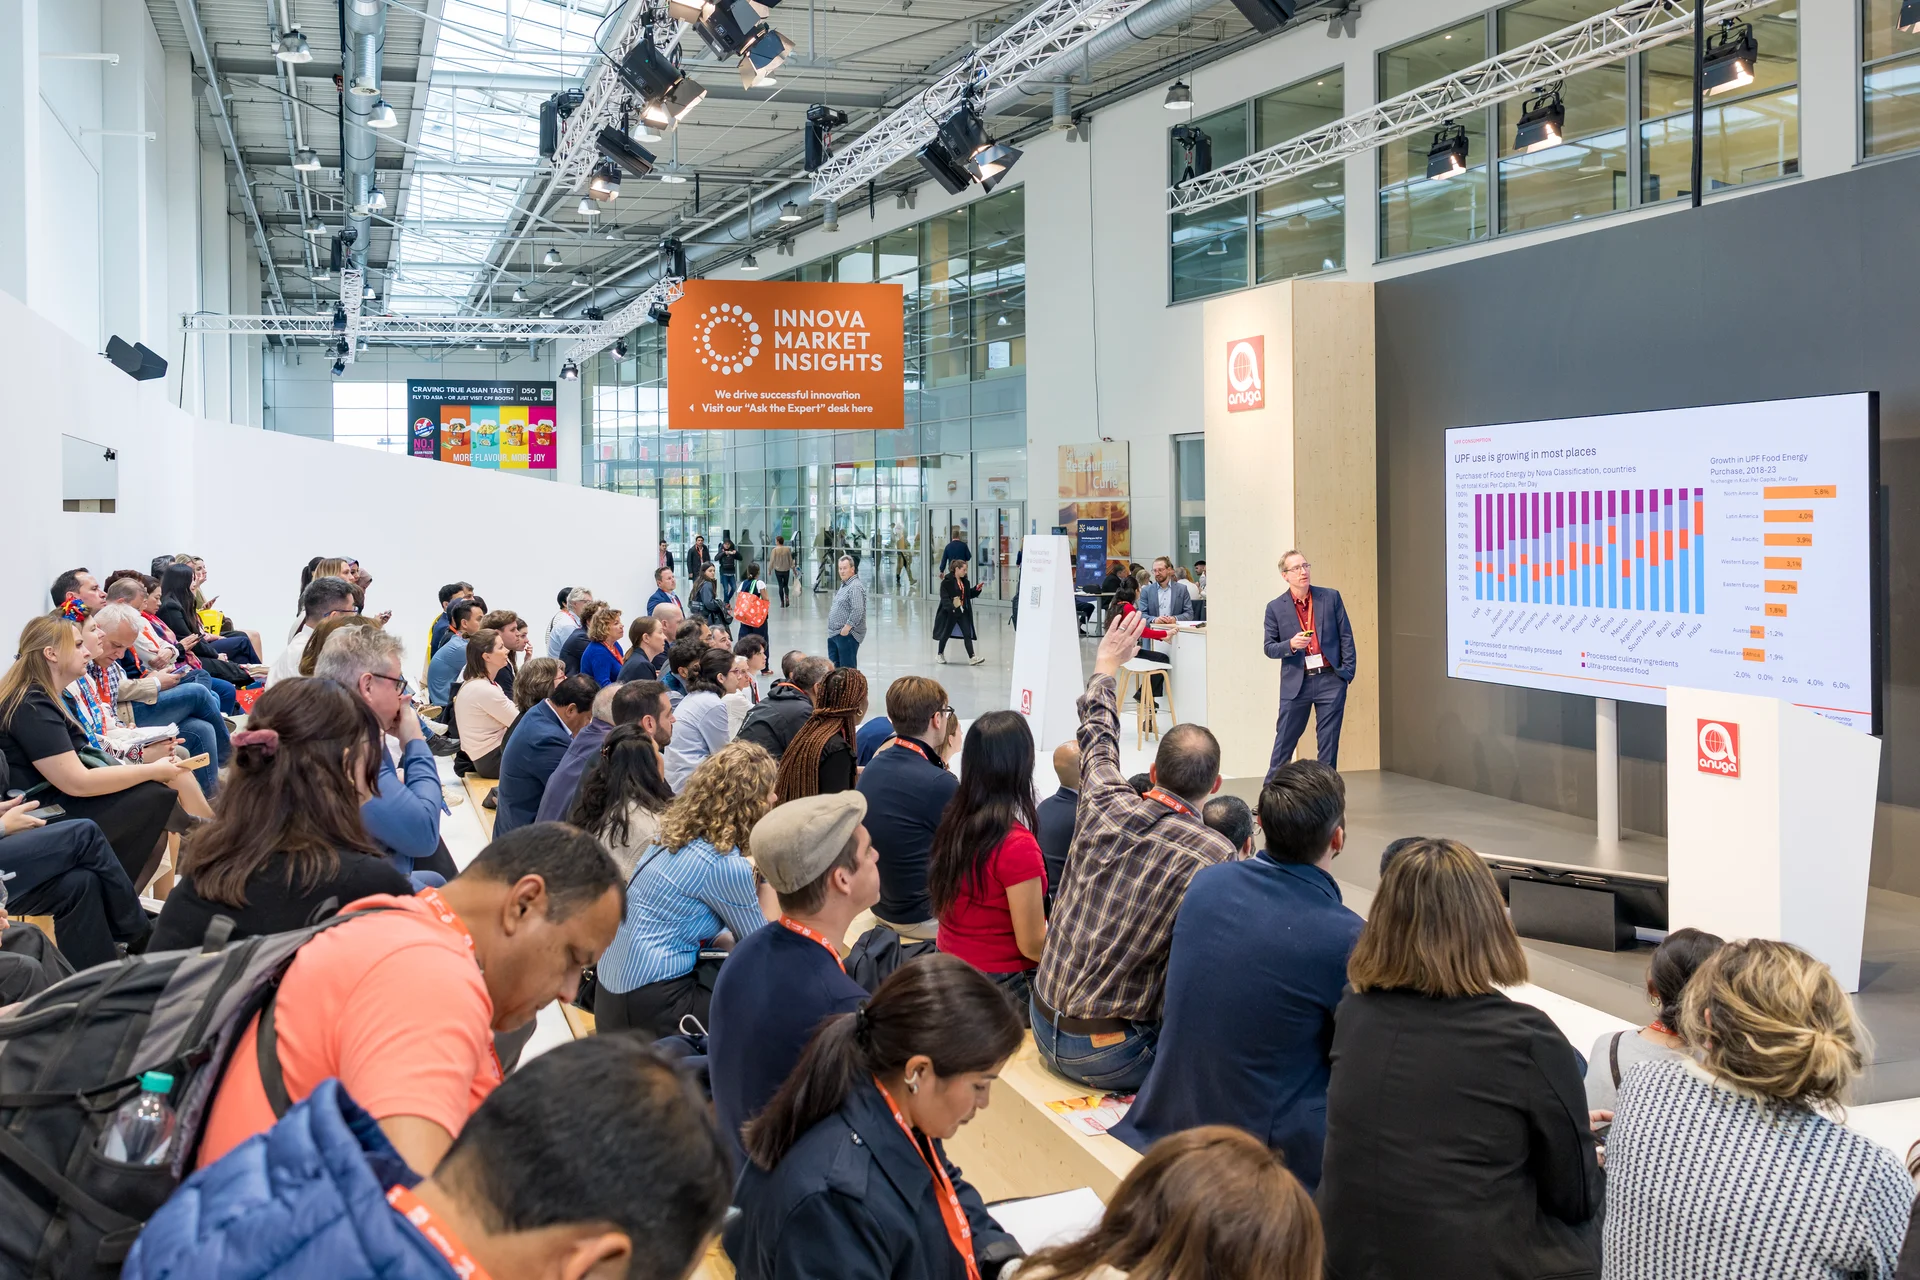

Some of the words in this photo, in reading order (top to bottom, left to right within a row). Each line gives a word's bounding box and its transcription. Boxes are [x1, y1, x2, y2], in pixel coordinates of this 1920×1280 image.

[774, 309, 865, 328] INNOVA
[774, 332, 870, 349] MARKET
[775, 353, 882, 371] INSIGHTS
[715, 390, 731, 398] We
[733, 390, 758, 399] drive
[760, 390, 808, 399] successful
[811, 390, 860, 399] innovation
[1229, 390, 1261, 406] anuga
[702, 403, 724, 412] Visit
[745, 404, 767, 412] “Ask
[770, 404, 785, 412] the
[788, 404, 825, 414] Expert”
[828, 404, 850, 412] desk
[852, 404, 873, 412] here
[414, 438, 434, 448] NO.1
[453, 453, 474, 462] MORE
[475, 454, 509, 462] FLAVOUR,
[511, 454, 531, 462] MORE
[533, 454, 545, 462] JOY
[1455, 454, 1470, 463] UPF
[1488, 453, 1495, 461] is
[1497, 451, 1529, 463] growing
[1532, 450, 1539, 459] in
[1541, 448, 1563, 458] most
[1566, 447, 1596, 459] places
[1710, 456, 1735, 464] Growth
[1782, 454, 1808, 462] Energy
[1066, 460, 1118, 472] Restaurant
[1506, 470, 1526, 479] Energy
[1528, 470, 1534, 478] by
[1554, 467, 1601, 476] Classification,
[1603, 466, 1636, 474] countries
[1710, 467, 1745, 475] Purchase,
[1747, 466, 1776, 474] 2018-23
[1093, 476, 1118, 488] Curie
[1471, 607, 1481, 618] USA
[1485, 607, 1492, 616] UK
[1491, 608, 1503, 624] Japan
[1552, 612, 1563, 625] Italy
[1491, 609, 1515, 639] Netherlands
[1508, 610, 1526, 632] Australia
[1519, 611, 1538, 634] Germany
[1534, 612, 1550, 630] France
[1560, 614, 1576, 632] Russia
[1572, 614, 1588, 634] Poland
[1590, 614, 1602, 628] UAE
[1600, 617, 1614, 634] China
[1611, 617, 1628, 638] Mexico
[1620, 619, 1642, 645] Argentina
[1628, 636, 1643, 652] South
[1641, 620, 1657, 637] Africa
[1656, 621, 1672, 638] Brazil
[1671, 621, 1687, 639] Egypt
[1687, 622, 1702, 638] India
[1469, 640, 1501, 649] Unprocessed
[1508, 644, 1533, 653] minimally
[1534, 647, 1562, 655] processed
[1470, 649, 1494, 658] Processed
[1587, 652, 1617, 661] Processed
[1618, 656, 1642, 665] culinary
[1644, 658, 1679, 668] ingredients
[1587, 662, 1634, 673] Ultra-processed
[1733, 671, 1750, 679] -2,0%
[1782, 676, 1798, 684] 2,0%
[1807, 679, 1824, 687] 4,0%
[1833, 681, 1850, 690] 6,0%
[1699, 758, 1737, 774] anuga
